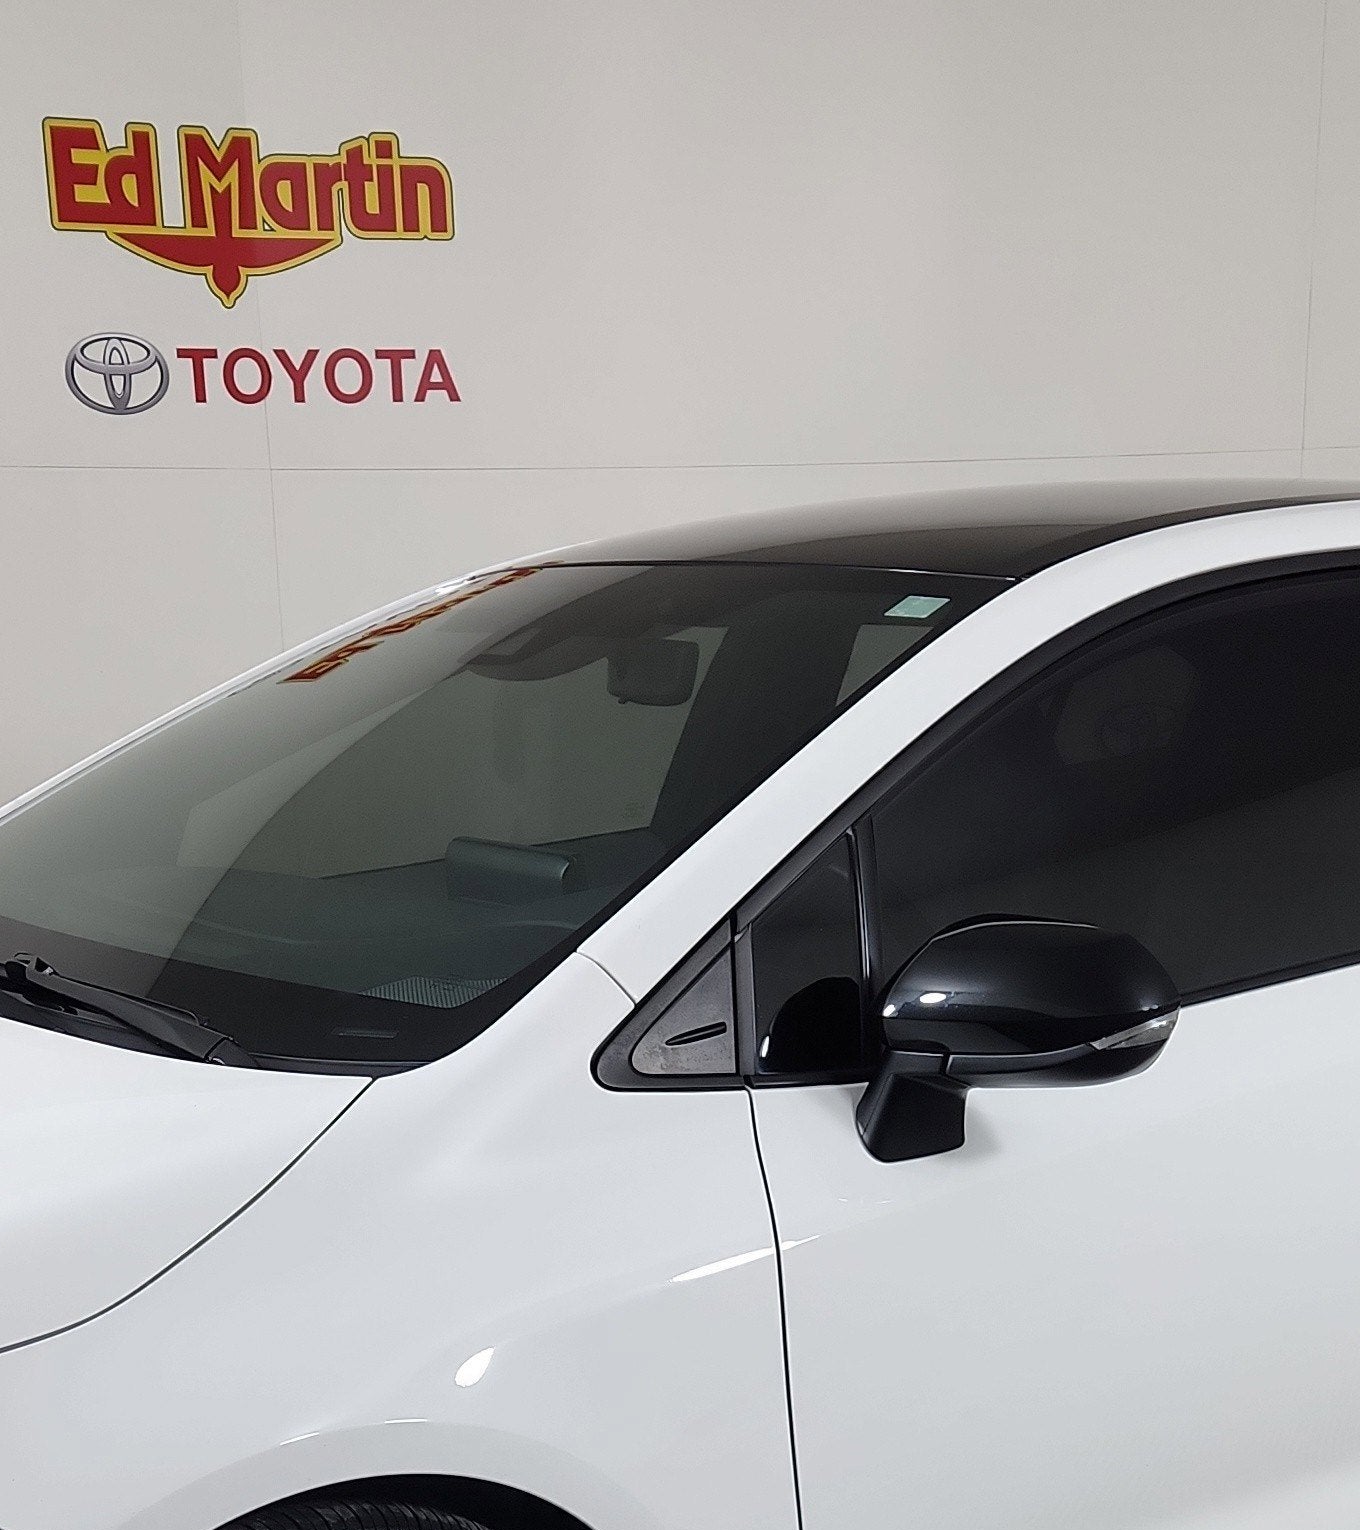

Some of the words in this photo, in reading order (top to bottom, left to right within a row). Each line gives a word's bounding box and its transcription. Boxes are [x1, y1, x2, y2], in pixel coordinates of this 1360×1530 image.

[44, 119, 162, 229] Ed
[178, 128, 452, 240] Martin
[177, 347, 461, 405] TOYOTA
